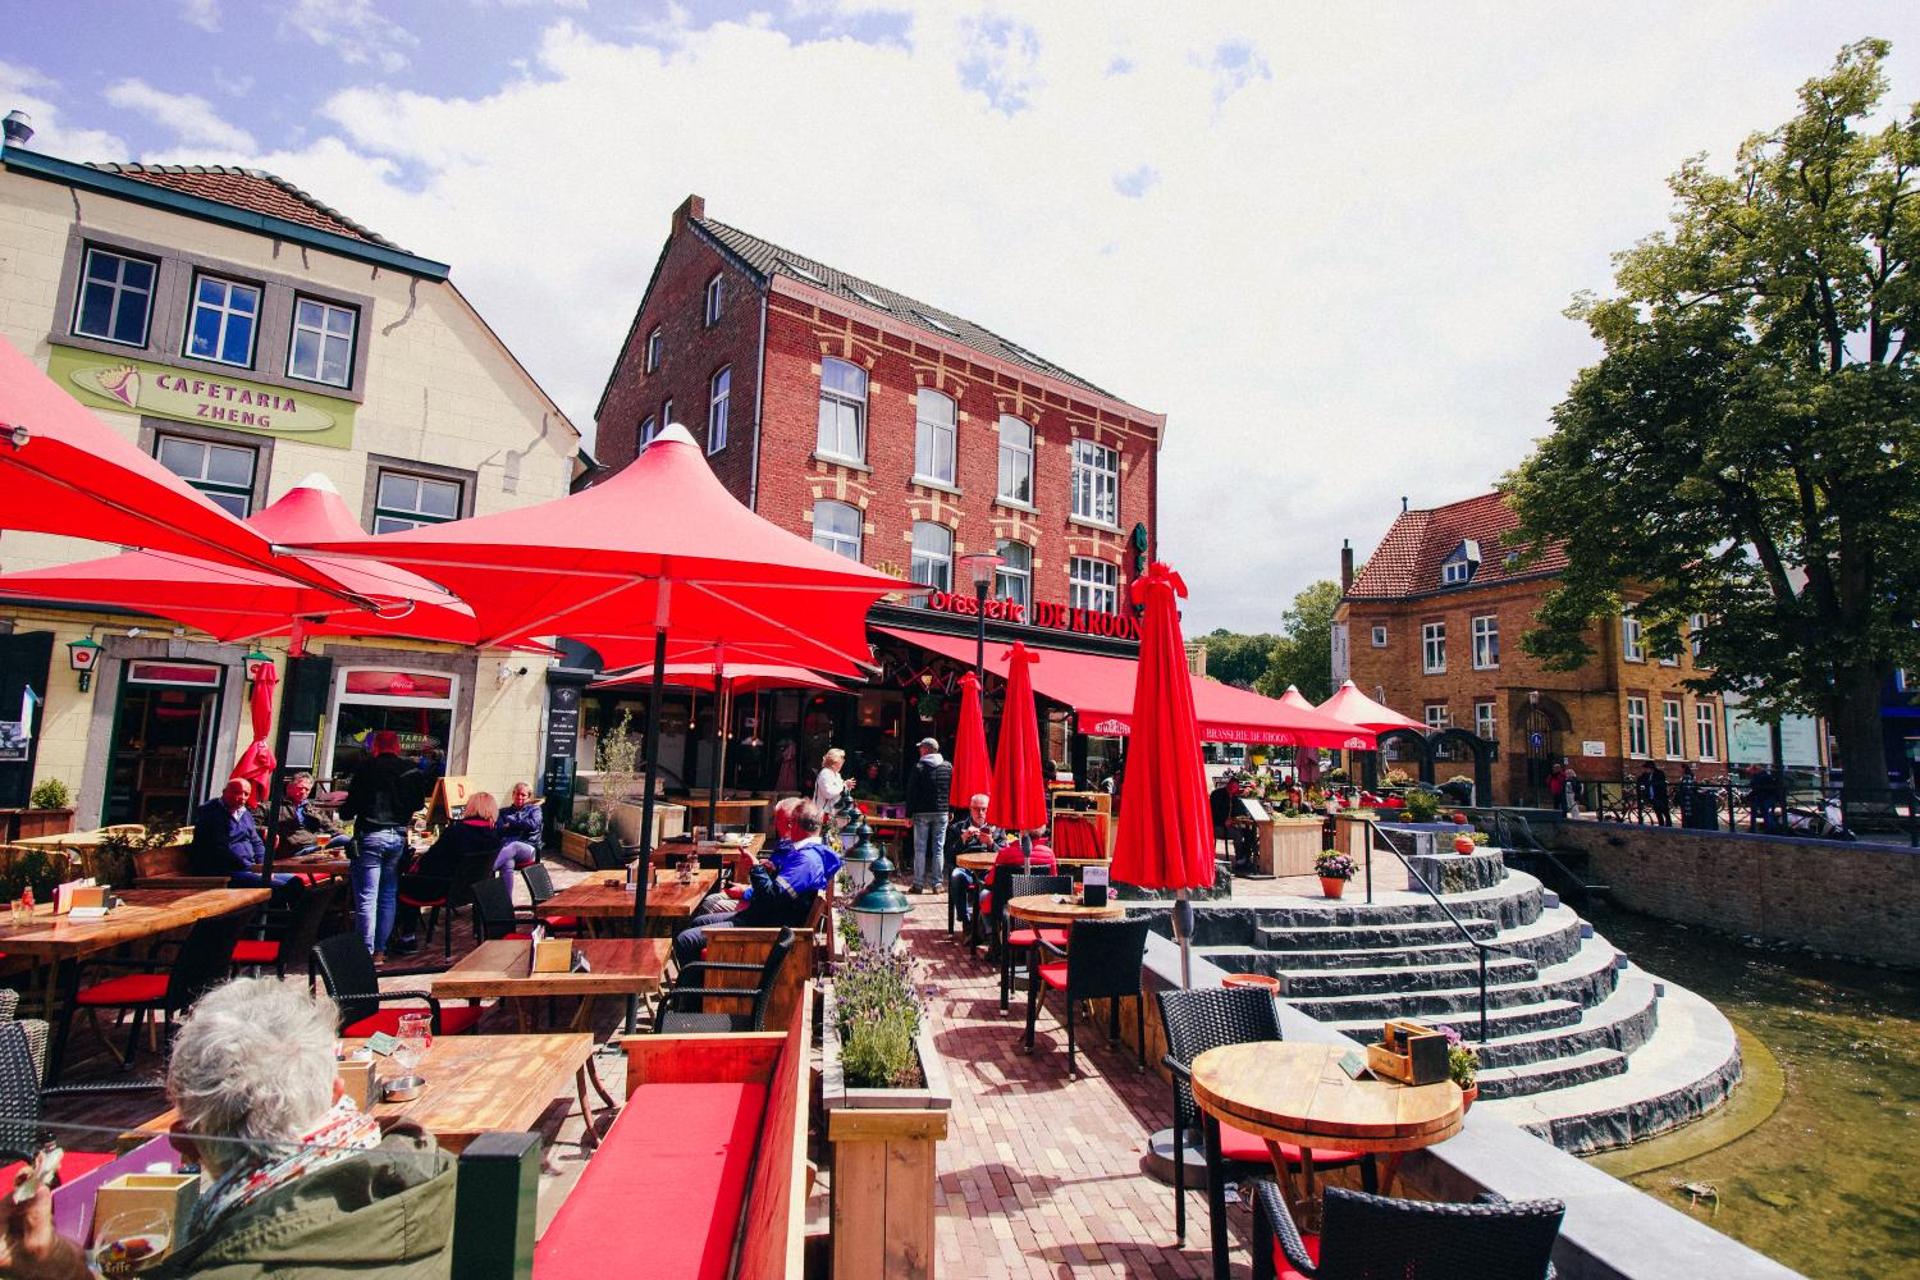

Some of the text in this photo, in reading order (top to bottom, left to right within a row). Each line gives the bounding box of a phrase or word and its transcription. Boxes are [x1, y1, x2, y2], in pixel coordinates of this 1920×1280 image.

[156, 374, 297, 413] CAFETARIA
[197, 403, 271, 428] ZHENG
[1037, 600, 1066, 629] DE
[1206, 727, 1249, 741] BRASSERIE
[1251, 730, 1261, 742] DE
